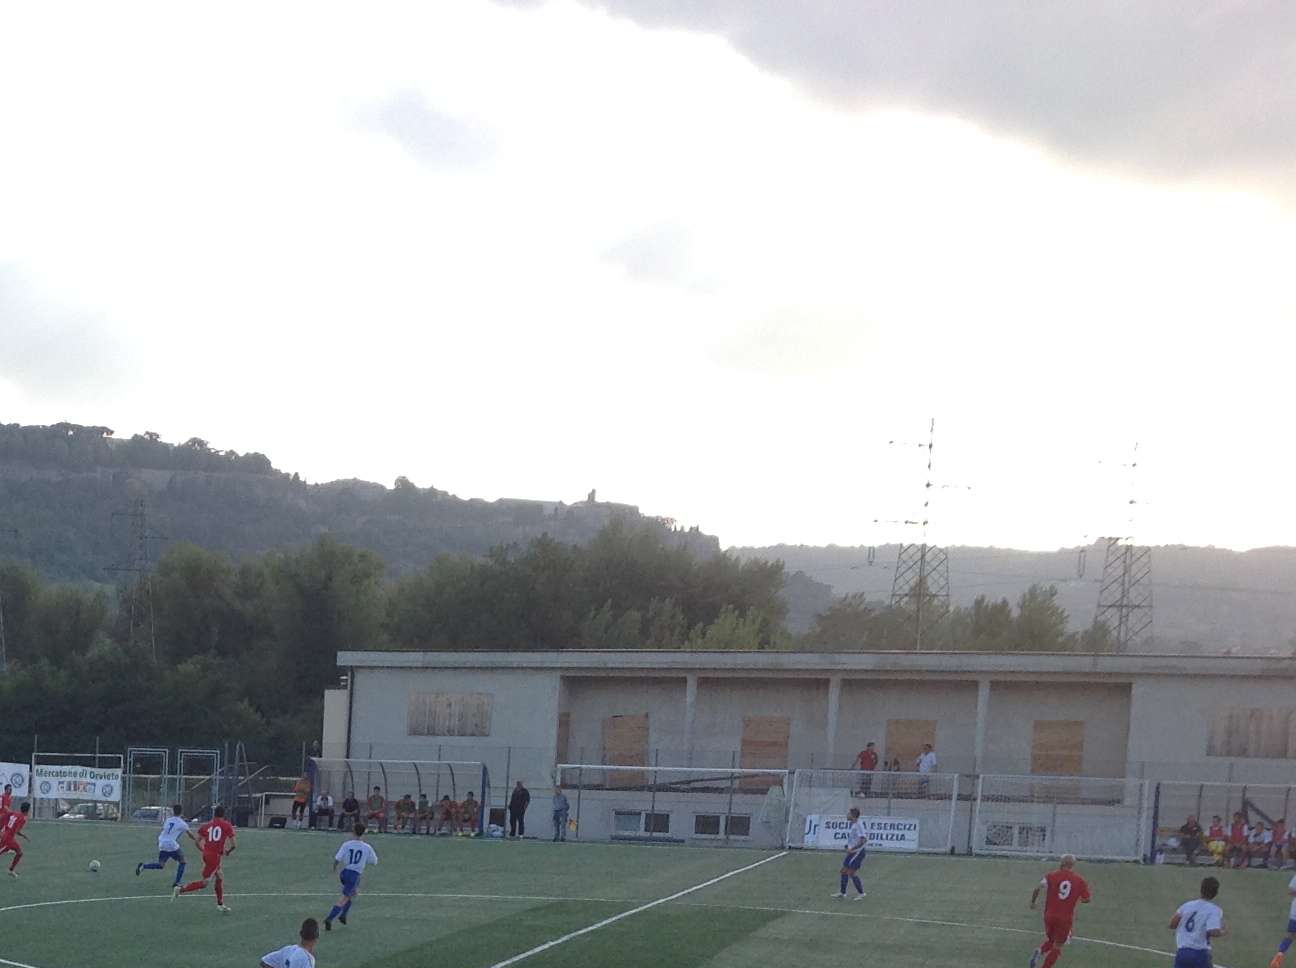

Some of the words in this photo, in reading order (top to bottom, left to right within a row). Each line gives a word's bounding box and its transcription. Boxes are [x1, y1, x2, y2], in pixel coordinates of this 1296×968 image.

[78, 769, 88, 779] di
[89, 770, 119, 780] Orvieto
[207, 825, 222, 842] 10
[870, 822, 917, 831] ESERCIZI
[865, 832, 906, 841] DILIZIA
[349, 848, 363, 865] 10
[1058, 880, 1072, 900] 9
[1185, 910, 1198, 933] 6
